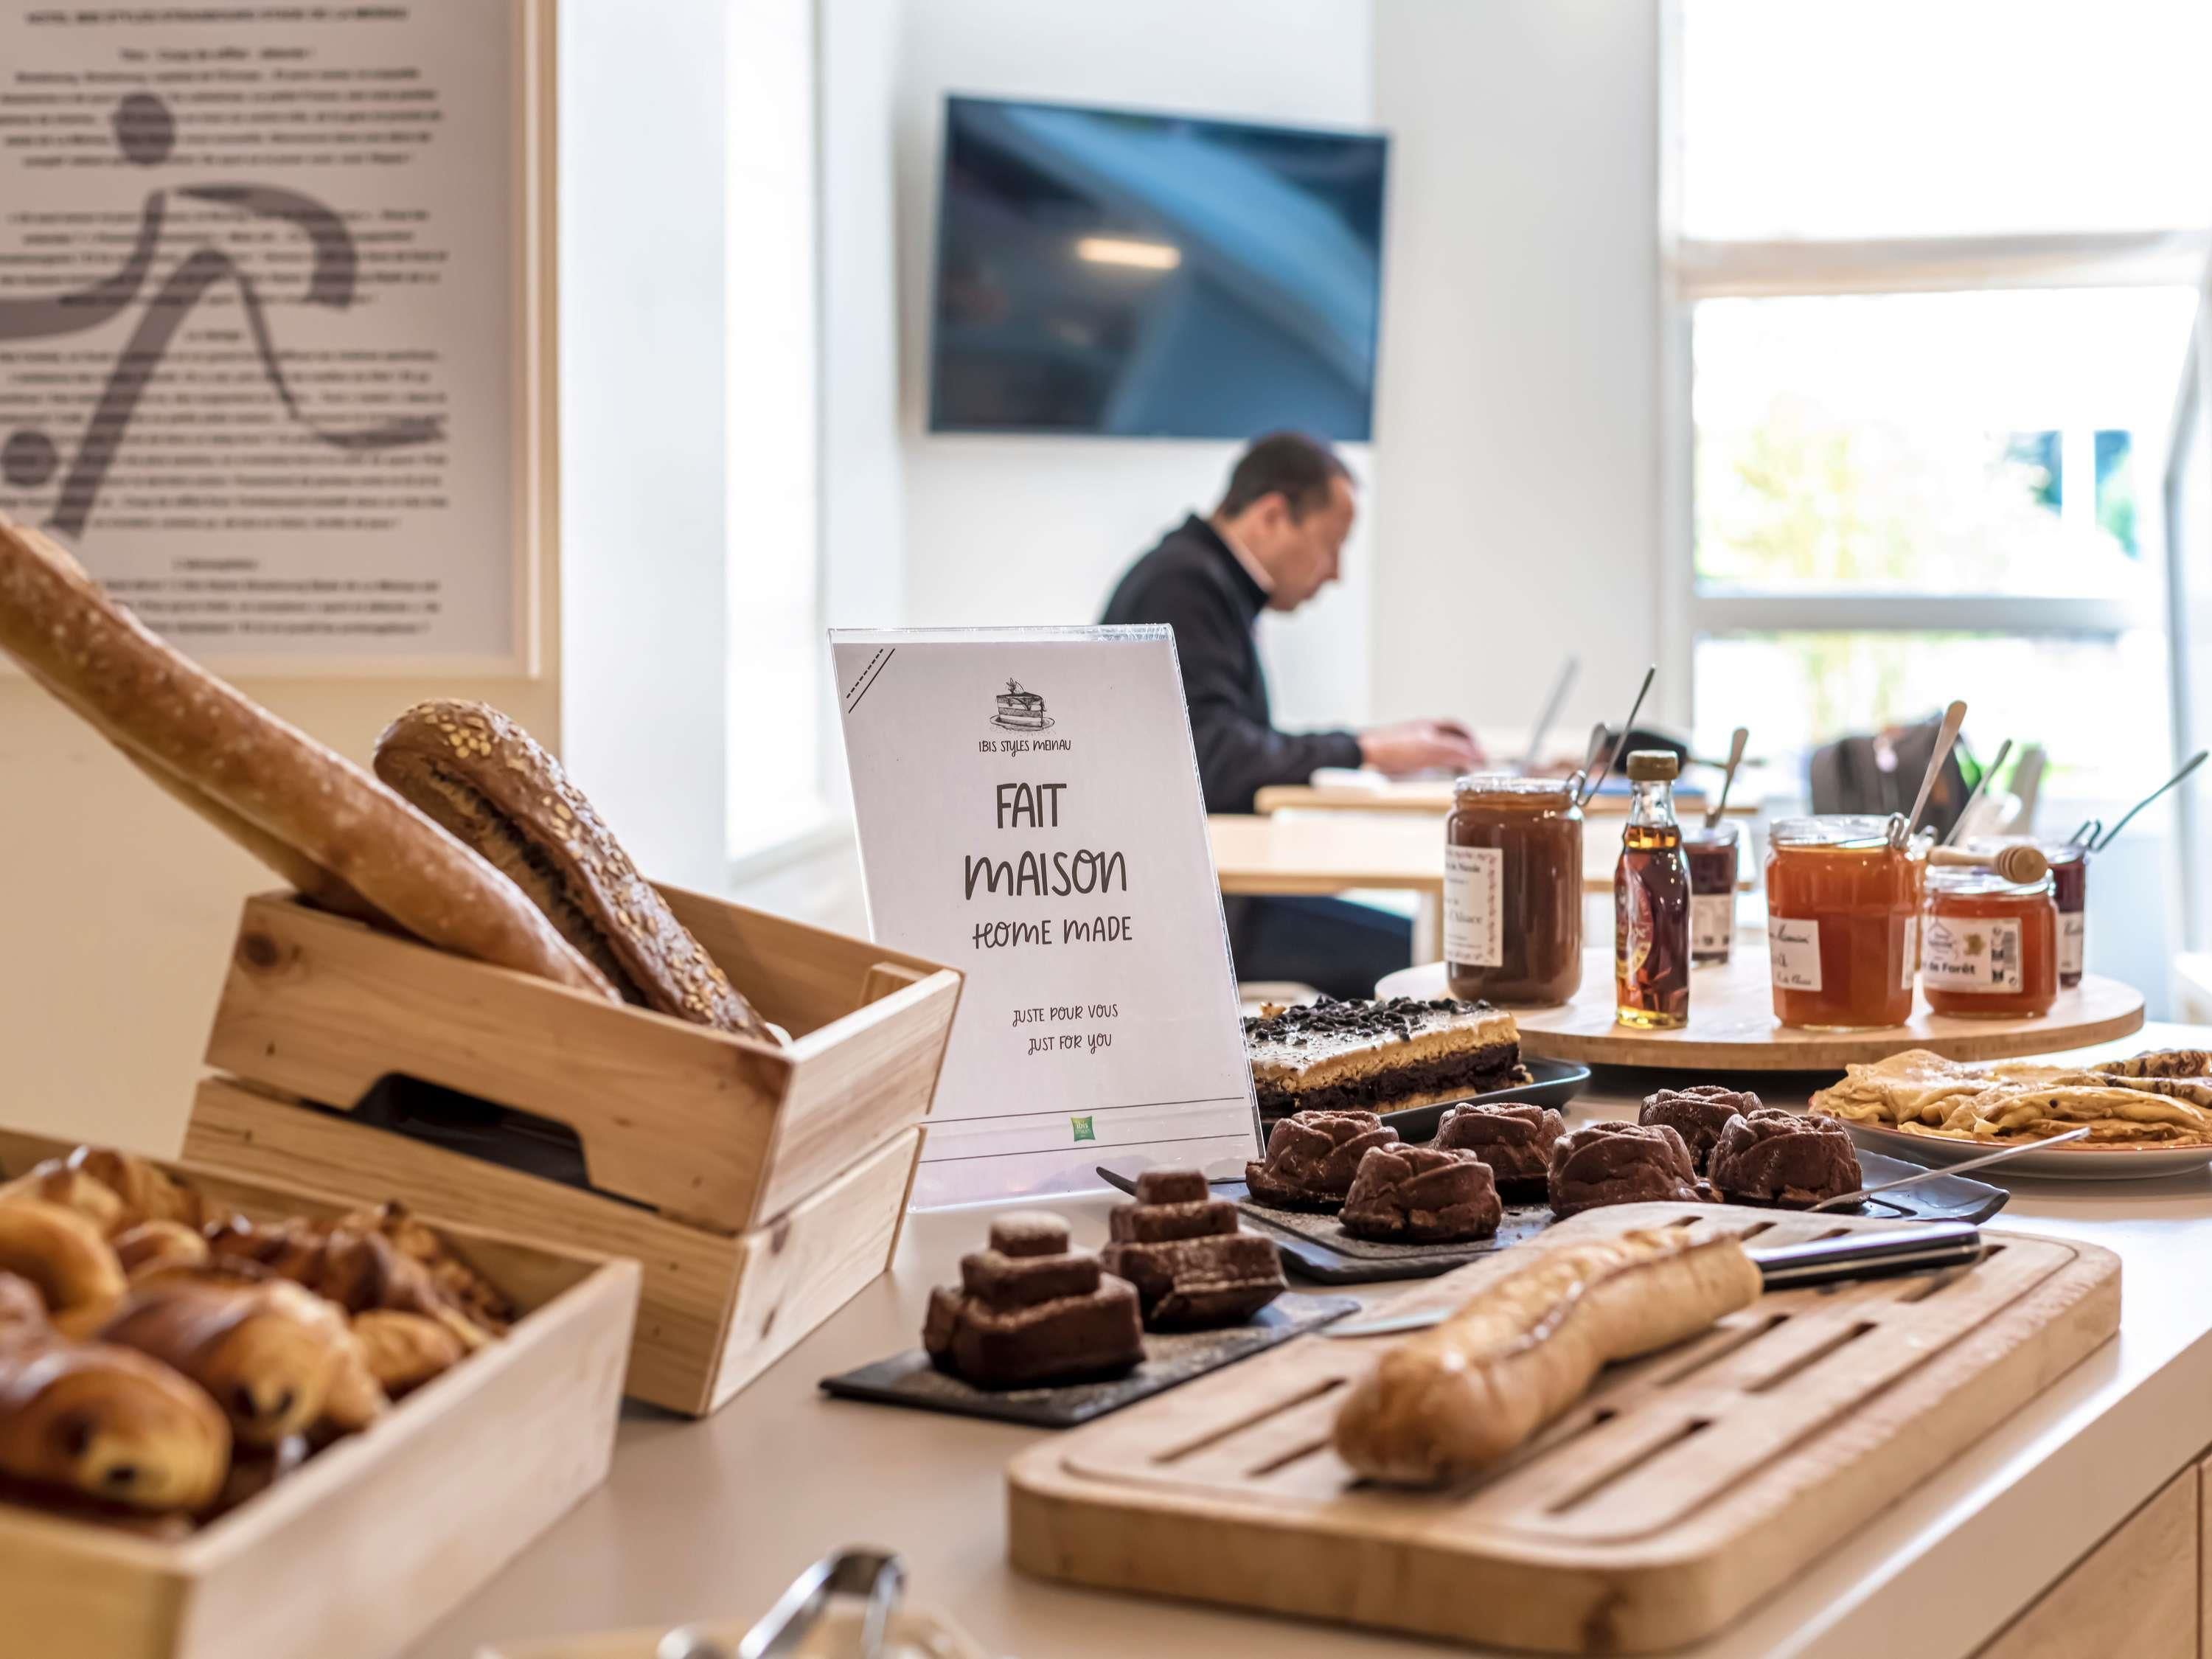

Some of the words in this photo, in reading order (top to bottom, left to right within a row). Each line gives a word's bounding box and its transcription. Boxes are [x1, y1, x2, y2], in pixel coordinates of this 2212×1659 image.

[978, 740, 997, 753] IBIS
[1000, 740, 1030, 758] STYLES
[1033, 739, 1071, 751] MEINAU
[996, 782, 1067, 830] FAIT
[964, 849, 1127, 901] MAISON
[972, 919, 1052, 950] HOME
[1063, 916, 1133, 945] MADE
[1012, 1008, 1045, 1027] JUSTE
[1050, 1005, 1083, 1021] POUR
[1088, 1004, 1119, 1018] VOUS
[1028, 1037, 1055, 1056] JUST
[1059, 1034, 1082, 1050] FOR
[1088, 1032, 1112, 1055] YOU
